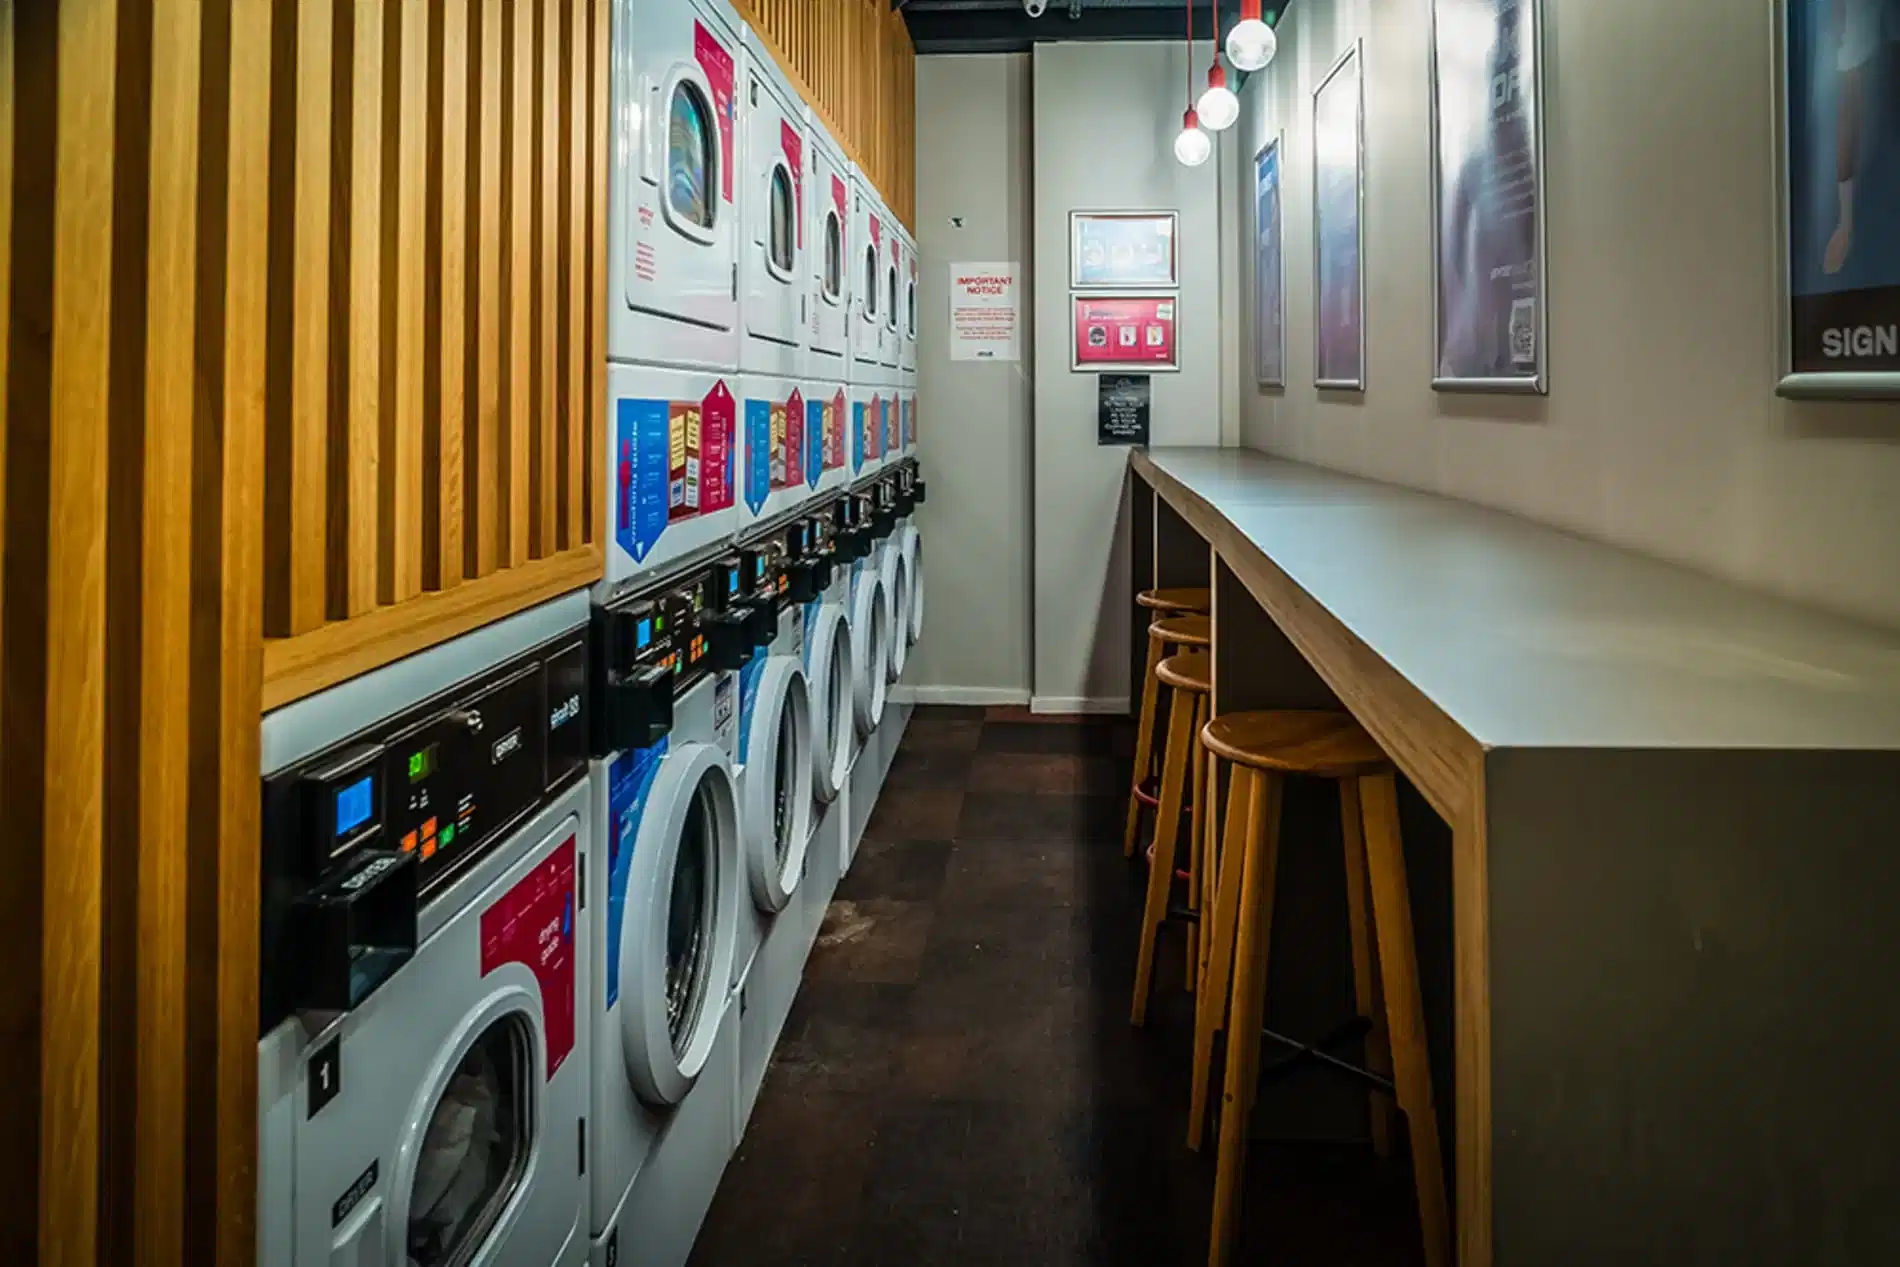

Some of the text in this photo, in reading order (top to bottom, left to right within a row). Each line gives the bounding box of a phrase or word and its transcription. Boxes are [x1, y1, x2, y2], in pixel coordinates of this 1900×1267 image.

[957, 276, 1012, 285] IMPORTANT
[967, 286, 1002, 295] NOTICE
[1822, 324, 1898, 358] SIGN
[320, 1061, 330, 1090] 1
